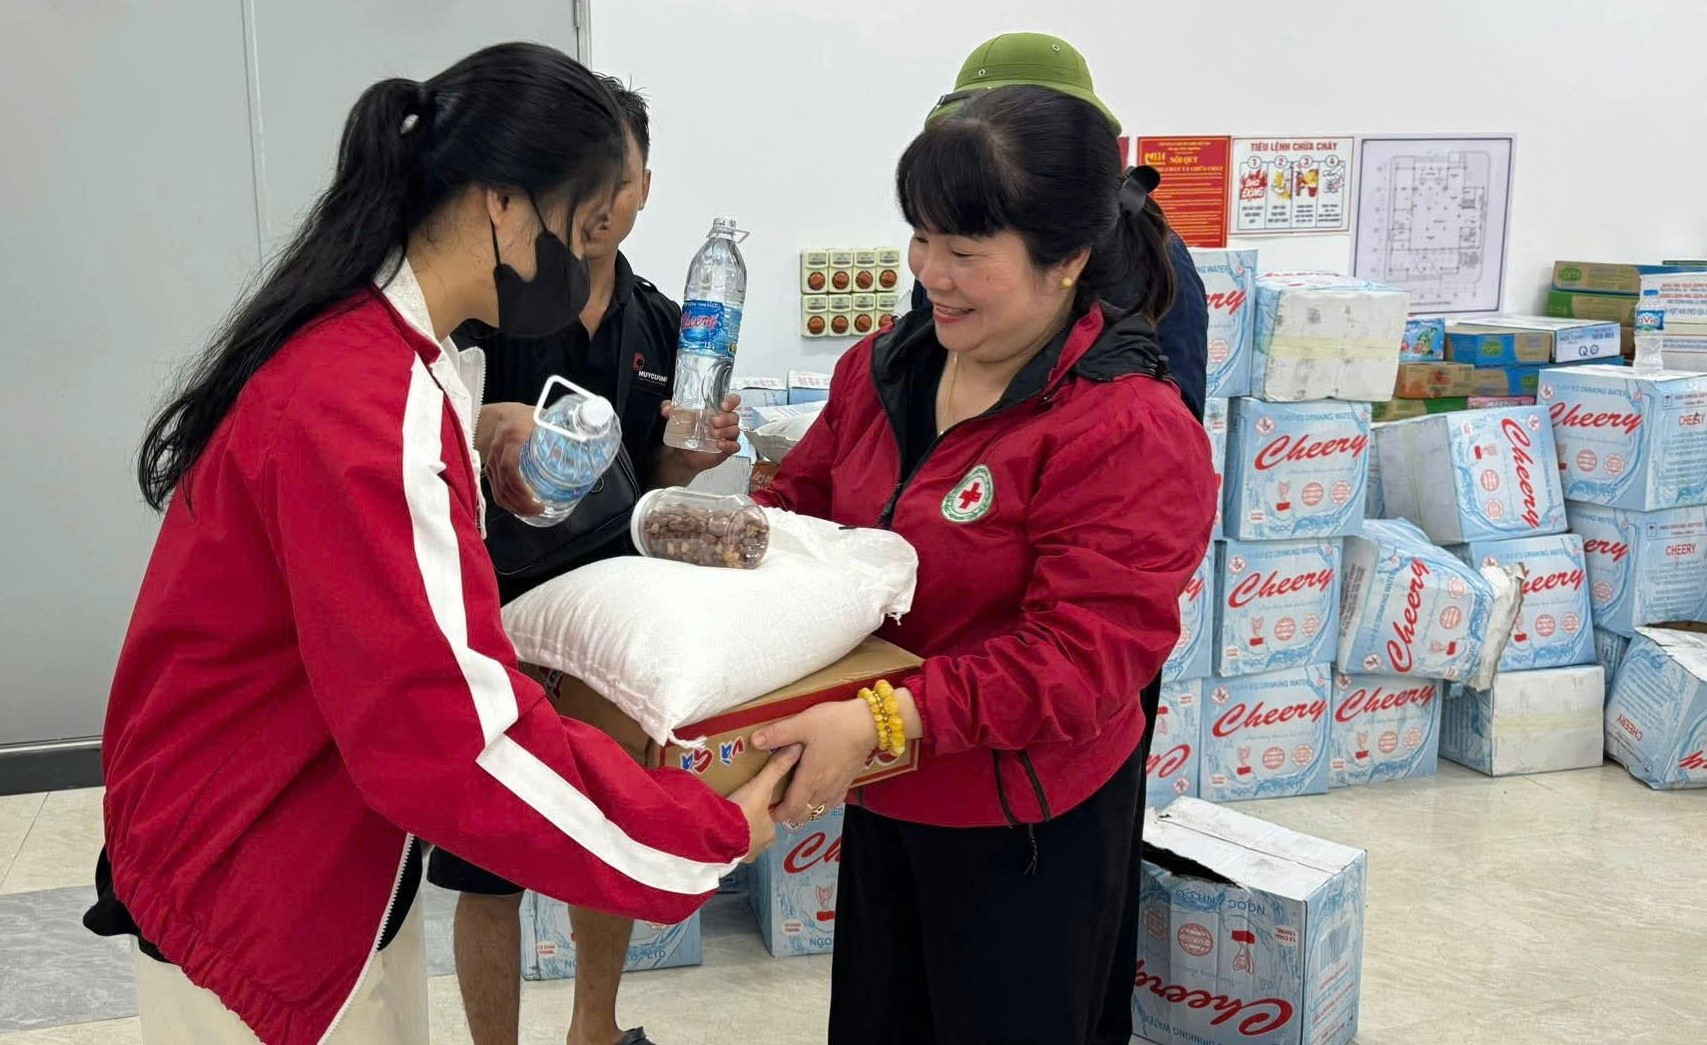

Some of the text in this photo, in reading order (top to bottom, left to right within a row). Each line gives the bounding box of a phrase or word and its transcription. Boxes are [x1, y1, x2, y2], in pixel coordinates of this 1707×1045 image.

[1278, 157, 1284, 165] 2
[1304, 157, 1309, 165] 3
[1549, 401, 1642, 435] Cheery
[1254, 434, 1368, 471] Cheery
[1501, 418, 1540, 529] Cheery
[1584, 538, 1630, 562] ery
[1665, 543, 1697, 557] CHEERY
[1228, 568, 1334, 609] Cheery
[1387, 557, 1430, 674] Cheery
[1212, 700, 1328, 738] Cheery
[1335, 685, 1437, 723] Cheery
[1617, 713, 1644, 742] CHEERY
